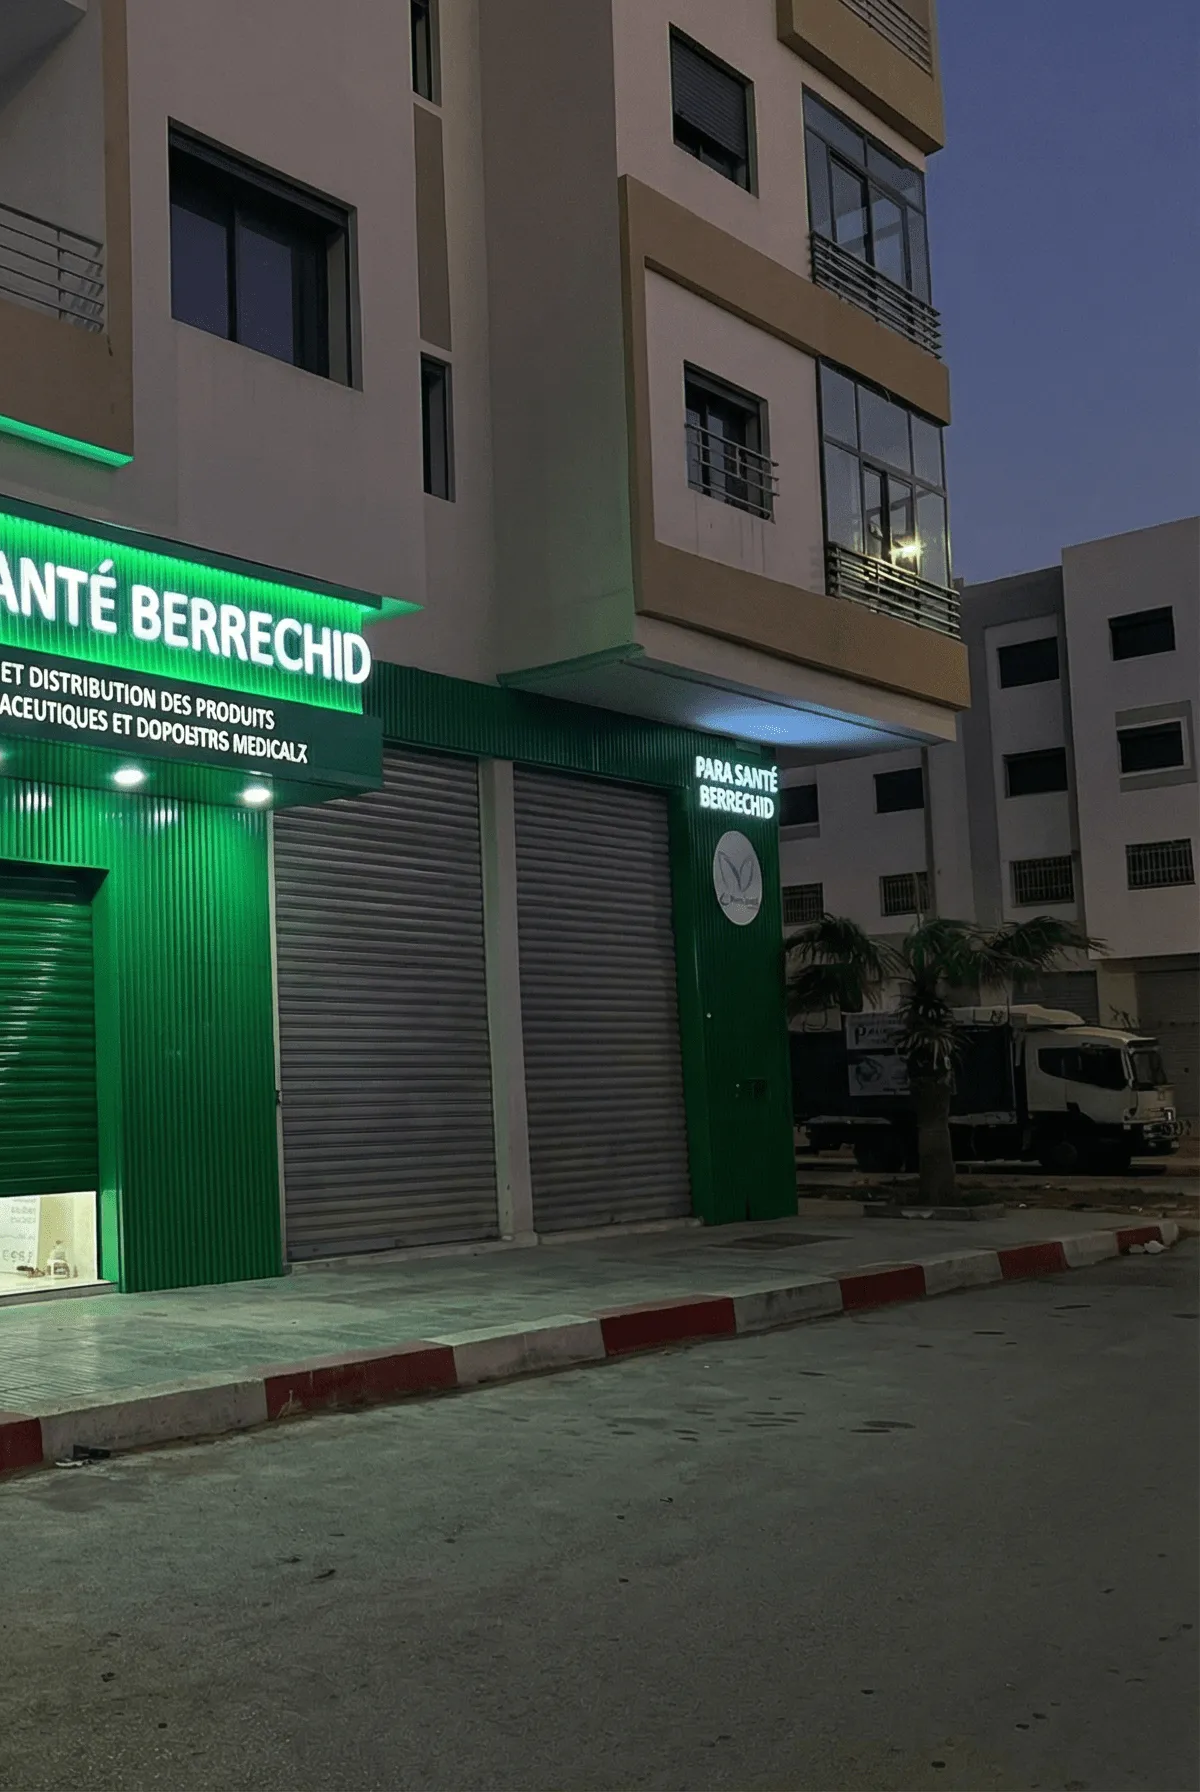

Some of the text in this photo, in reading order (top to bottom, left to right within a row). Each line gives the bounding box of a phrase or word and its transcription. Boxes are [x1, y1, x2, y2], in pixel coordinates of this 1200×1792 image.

[132, 584, 372, 684] BERRECHID
[1, 661, 25, 685] ET
[29, 666, 156, 709] DISTRIBUTION
[161, 691, 192, 716] DES
[196, 697, 275, 730] PRODUITS
[113, 712, 132, 735] ET
[695, 755, 778, 793] PARA SANTÉ
[699, 785, 775, 819] BERRECHID
